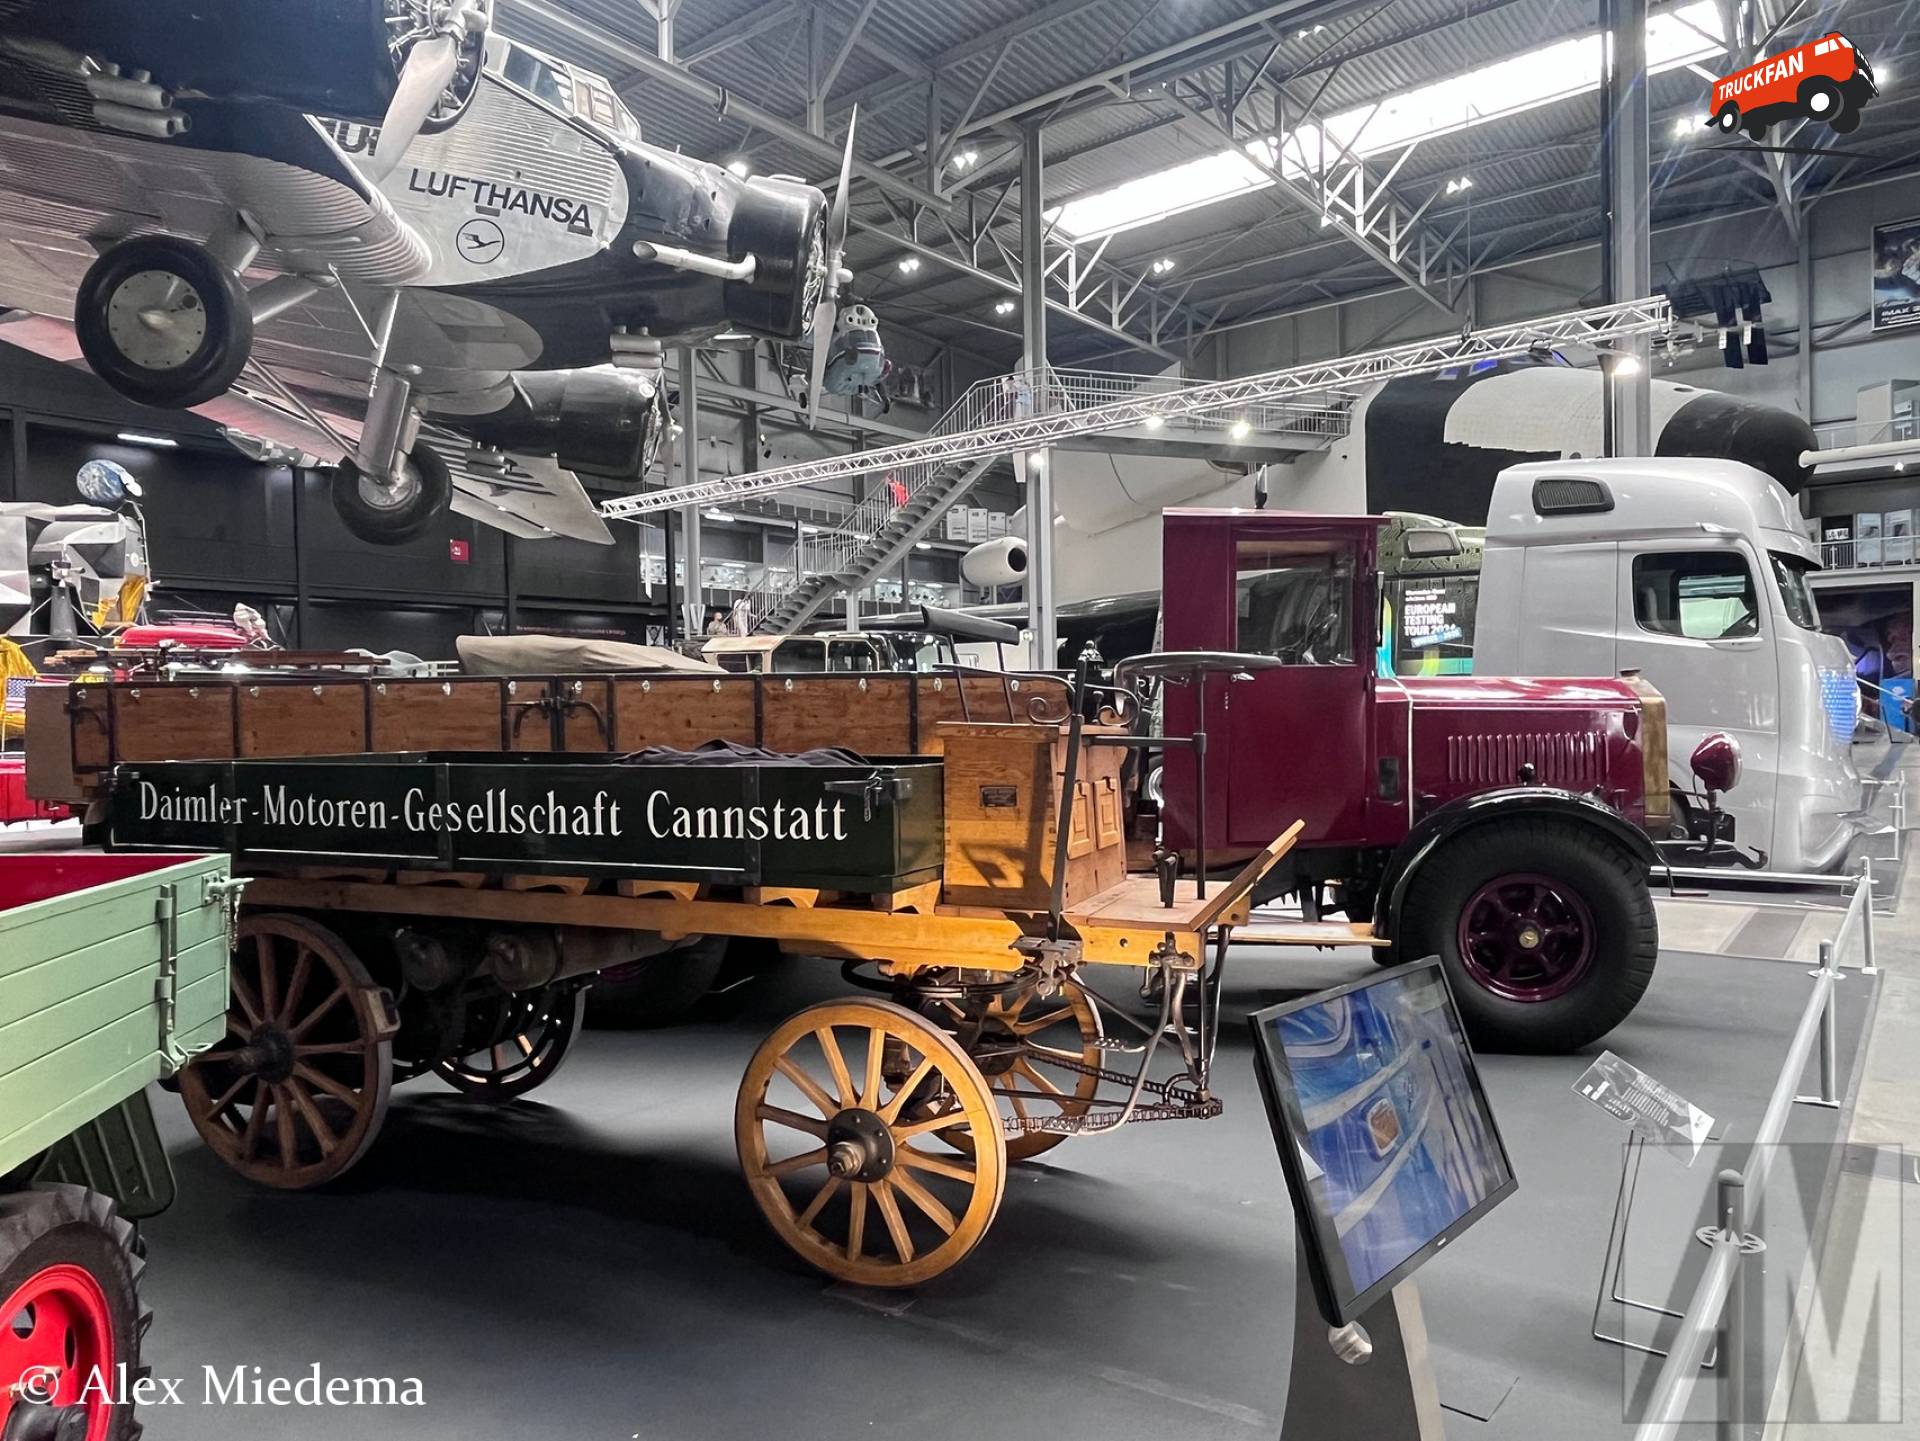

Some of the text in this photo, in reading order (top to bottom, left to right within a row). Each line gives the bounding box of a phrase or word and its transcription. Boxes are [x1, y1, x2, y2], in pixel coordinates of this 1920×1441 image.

[409, 168, 593, 230] LUFTHANSA
[1404, 602, 1456, 615] EUROPEAN
[1404, 614, 1445, 626] TESTING
[1404, 626, 1430, 636] TOUR
[646, 790, 848, 841] Cannstatt
